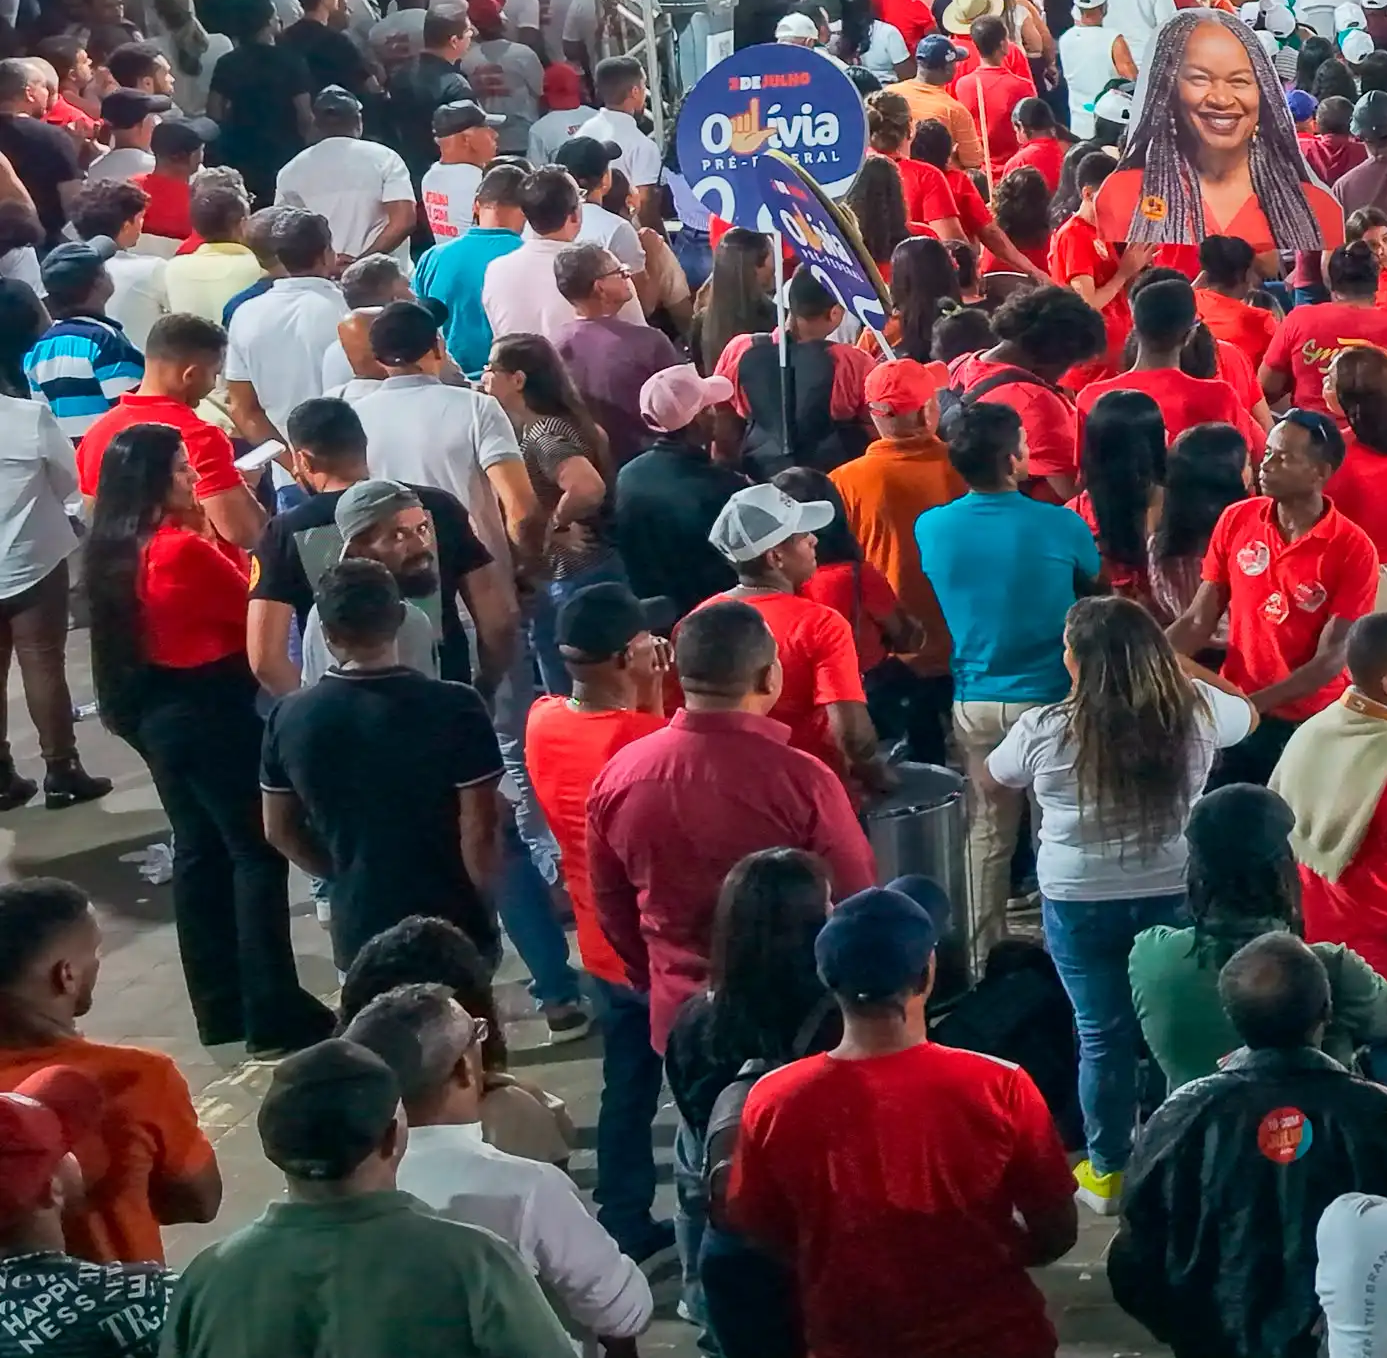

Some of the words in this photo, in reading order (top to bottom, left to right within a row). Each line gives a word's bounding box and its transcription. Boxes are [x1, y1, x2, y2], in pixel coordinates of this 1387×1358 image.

[1, 1277, 80, 1336] HAPPI
[18, 1294, 96, 1354] NESS
[1364, 1298, 1376, 1326] THE
